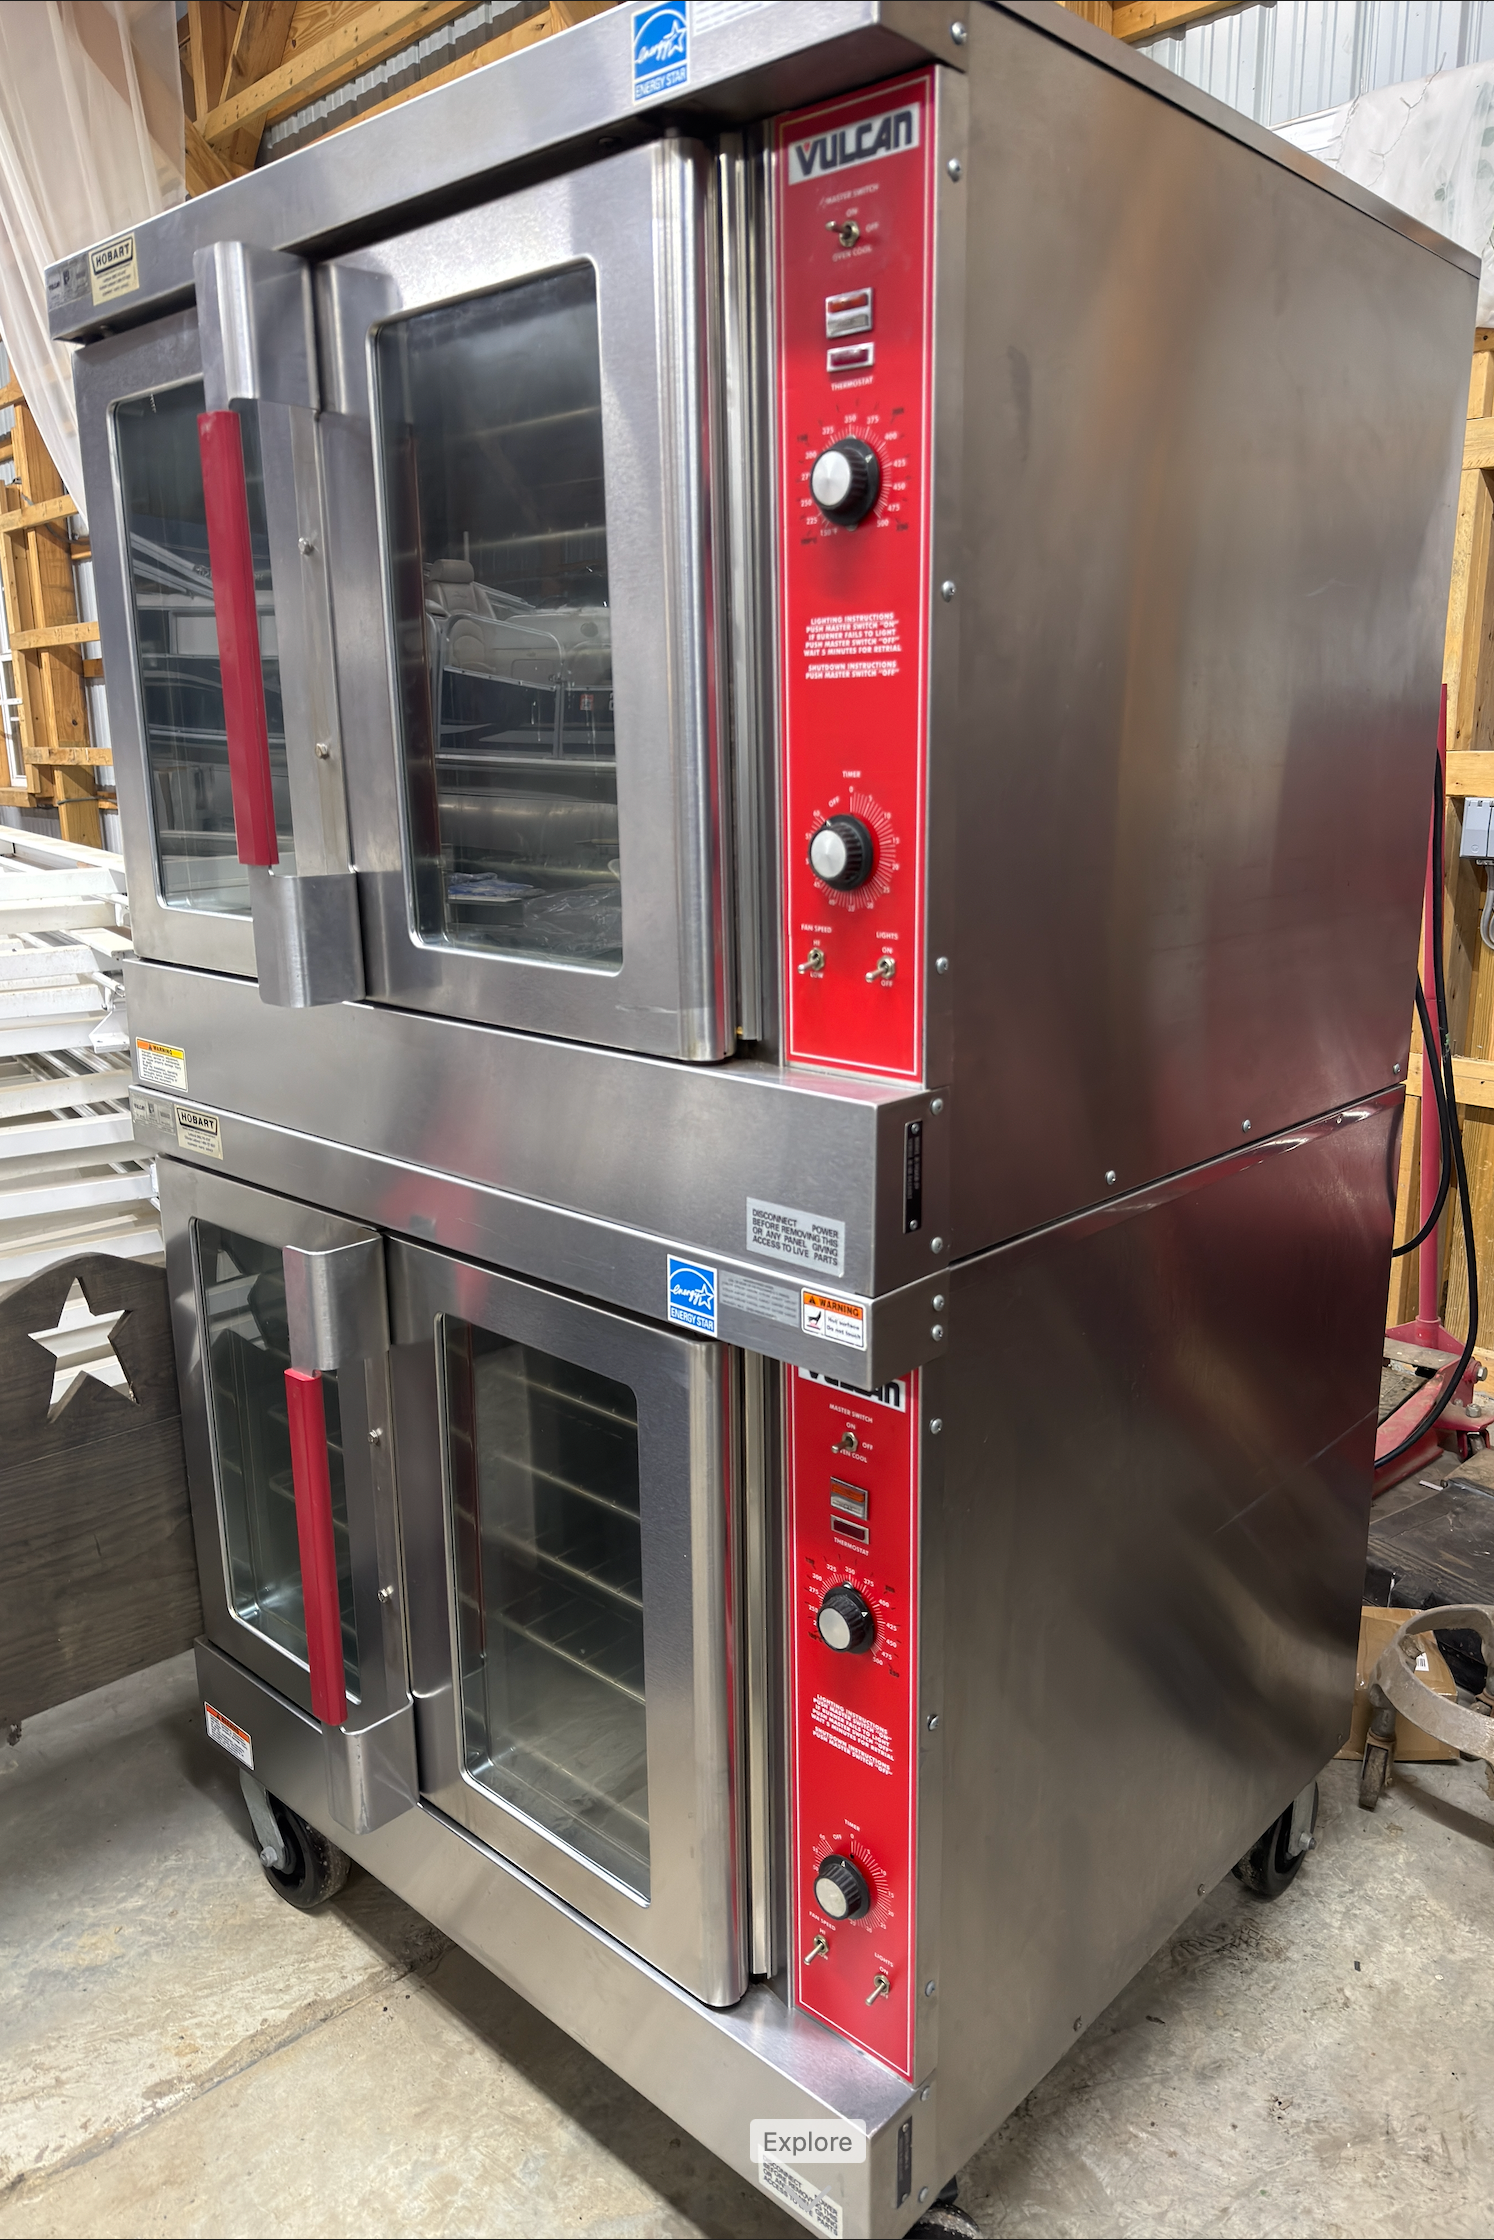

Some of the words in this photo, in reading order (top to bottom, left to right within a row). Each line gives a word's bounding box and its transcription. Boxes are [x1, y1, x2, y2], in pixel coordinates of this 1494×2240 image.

[636, 75, 665, 98] ENERGY
[666, 67, 686, 87] STAR
[796, 110, 913, 176] VULCAN
[846, 207, 858, 218] ON
[865, 222, 879, 232] OFF
[96, 242, 130, 268] HOBART
[830, 374, 874, 392] THERMOSTAT
[810, 616, 843, 626] LIGHTING
[844, 612, 894, 623] INSTRUCTIONS
[806, 625, 824, 634] PUSH
[824, 623, 851, 632] MASTER
[852, 622, 878, 631] SWITCH
[808, 633, 816, 641] IF
[816, 632, 844, 640] BURNER
[844, 630, 862, 639] FAILS
[864, 630, 874, 638] TO
[875, 628, 896, 637] LIGHT
[805, 641, 823, 649] PUSH
[824, 640, 850, 648] MASTER
[852, 638, 877, 646] SWITCH
[827, 647, 857, 656] MINUTES
[874, 644, 902, 653] RETRIAL
[808, 664, 846, 672] SHUTDOWN
[847, 660, 897, 670] INSTRUCTIONS
[806, 672, 823, 680] PUSH
[824, 670, 850, 678] MASTER
[852, 669, 877, 678] SWITCH
[842, 770, 862, 778] TIMER
[828, 796, 840, 808] OFF
[801, 923, 814, 932] FAN
[814, 924, 832, 934] SPEED
[876, 931, 898, 940] LIGHTS
[882, 946, 894, 954] ON
[881, 980, 894, 988] OFF
[181, 1112, 214, 1130] HOBART
[752, 1208, 798, 1228] DISCONNECT
[812, 1224, 838, 1238] POWER
[752, 1218, 780, 1232] BEFORE
[782, 1226, 820, 1242] REMOVING
[822, 1236, 838, 1248] THIS
[752, 1226, 763, 1236] OR
[766, 1230, 781, 1240] ANY
[784, 1235, 807, 1248] PANEL
[812, 1243, 838, 1257] GIVING
[752, 1236, 781, 1250] ACCESS
[782, 1243, 792, 1253] TO
[792, 1248, 809, 1258] LIVE
[814, 1252, 838, 1266] PARTS
[818, 1298, 859, 1317] WARNING
[671, 1307, 697, 1324] ENERGY
[697, 1316, 714, 1331] STAR
[829, 1403, 850, 1416] MASTER
[852, 1411, 874, 1424] SWITCH
[846, 1422, 856, 1430] ON
[862, 1442, 874, 1450] OFF
[852, 1451, 868, 1464] COOL
[834, 1536, 870, 1556] THERMOSTAT
[812, 1697, 828, 1711] PUSH
[829, 1706, 852, 1722] MASTER
[852, 1718, 874, 1734] SWITCH
[812, 1708, 828, 1721] PUSH
[828, 1716, 851, 1732] MASTER
[852, 1729, 874, 1744] SWITCH
[862, 1728, 870, 1737] TO
[812, 1730, 828, 1742] PUSH
[828, 1740, 851, 1756] MASTER
[852, 1752, 874, 1768] SWITCH
[858, 1738, 870, 1748] FOR
[844, 1818, 860, 1832] TIMER
[808, 1910, 820, 1922] FAN
[820, 1918, 836, 1932] SPEED
[819, 1928, 826, 1936] HI
[874, 1952, 894, 1968] LIGHTS
[879, 1966, 889, 1976] ON
